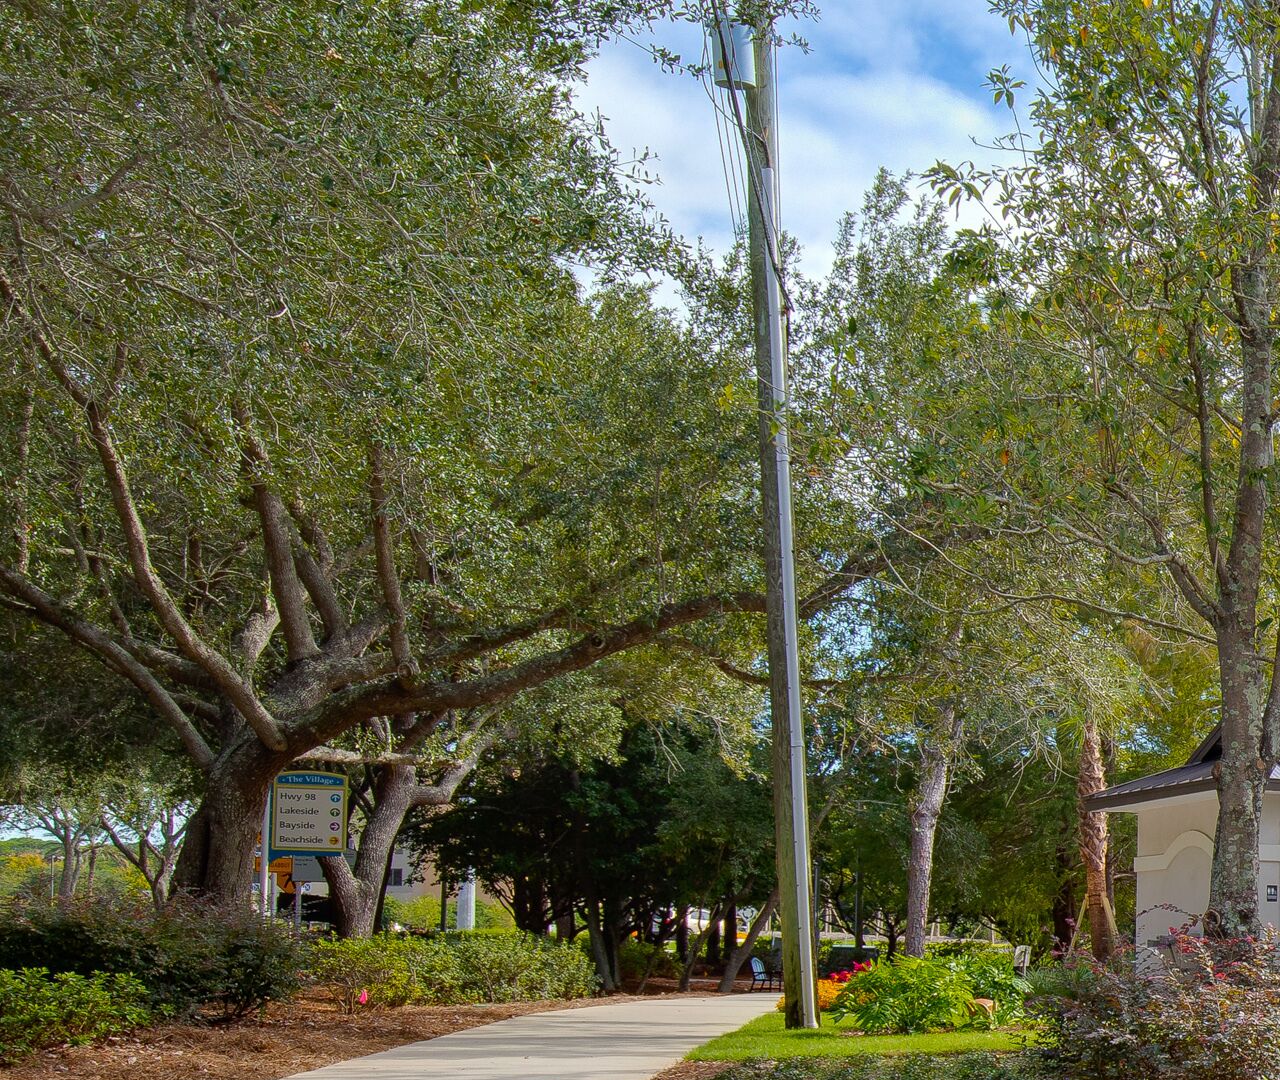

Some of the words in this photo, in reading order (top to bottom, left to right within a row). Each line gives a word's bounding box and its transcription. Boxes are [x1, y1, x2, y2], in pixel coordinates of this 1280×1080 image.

[287, 775, 303, 783] The
[305, 775, 334, 784] Village
[280, 793, 302, 801] Hwy
[280, 807, 319, 815] Lakeside
[280, 821, 315, 830] Bayside
